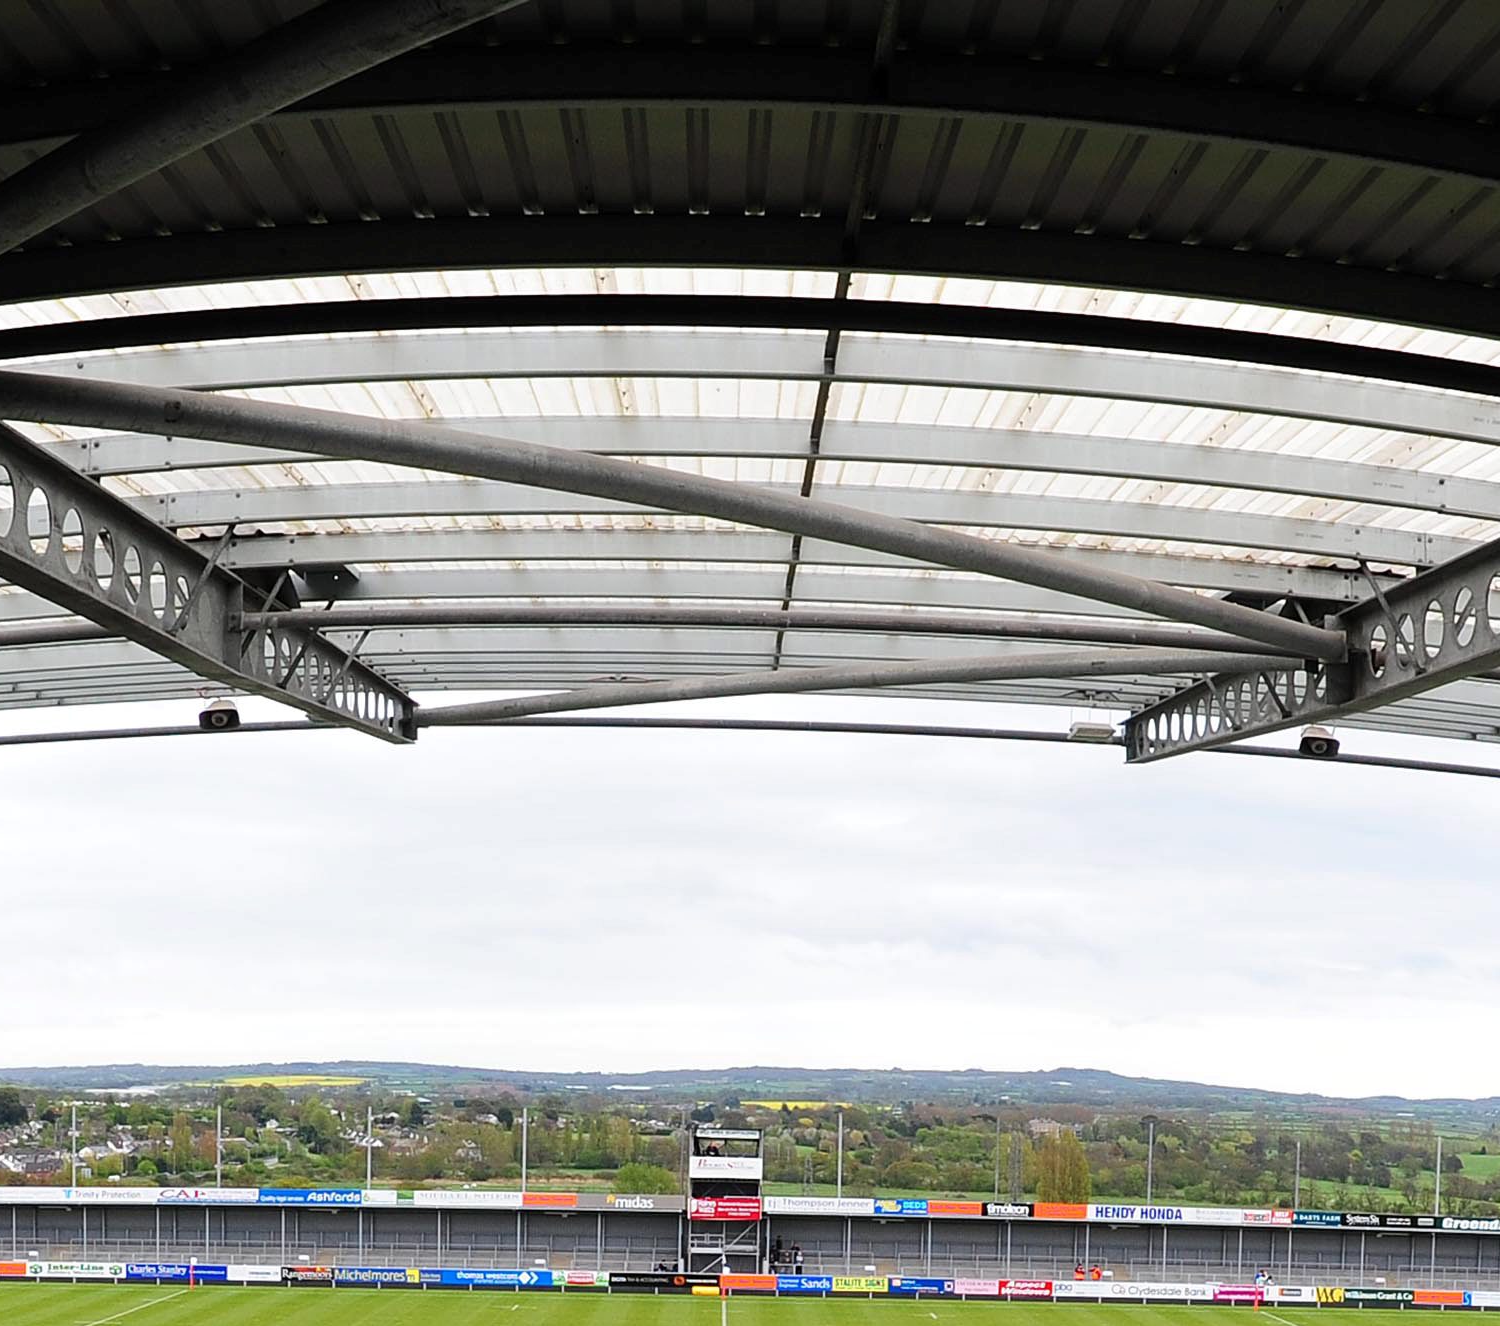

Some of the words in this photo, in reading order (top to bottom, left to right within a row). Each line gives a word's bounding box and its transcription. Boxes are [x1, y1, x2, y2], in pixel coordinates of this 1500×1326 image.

[75, 1190, 100, 1199] Trinity
[102, 1190, 141, 1200] Protection
[307, 1191, 362, 1204] Ashfords
[615, 1196, 654, 1209] midas
[783, 1199, 835, 1209] Thompson
[837, 1199, 871, 1209] Jenner
[1095, 1206, 1136, 1219] HENDY
[1140, 1207, 1182, 1221] HONDA
[47, 1263, 104, 1272] Inter-Line
[127, 1264, 156, 1275] Charles
[157, 1265, 187, 1277] Stanley
[334, 1269, 405, 1282] Michelmores
[456, 1271, 485, 1280] thomas
[801, 1278, 831, 1289] Sands
[1006, 1281, 1046, 1289] Aspect
[1001, 1287, 1051, 1297] Windows
[1128, 1285, 1184, 1297] Clydesdale
[1184, 1286, 1206, 1297] Bank
